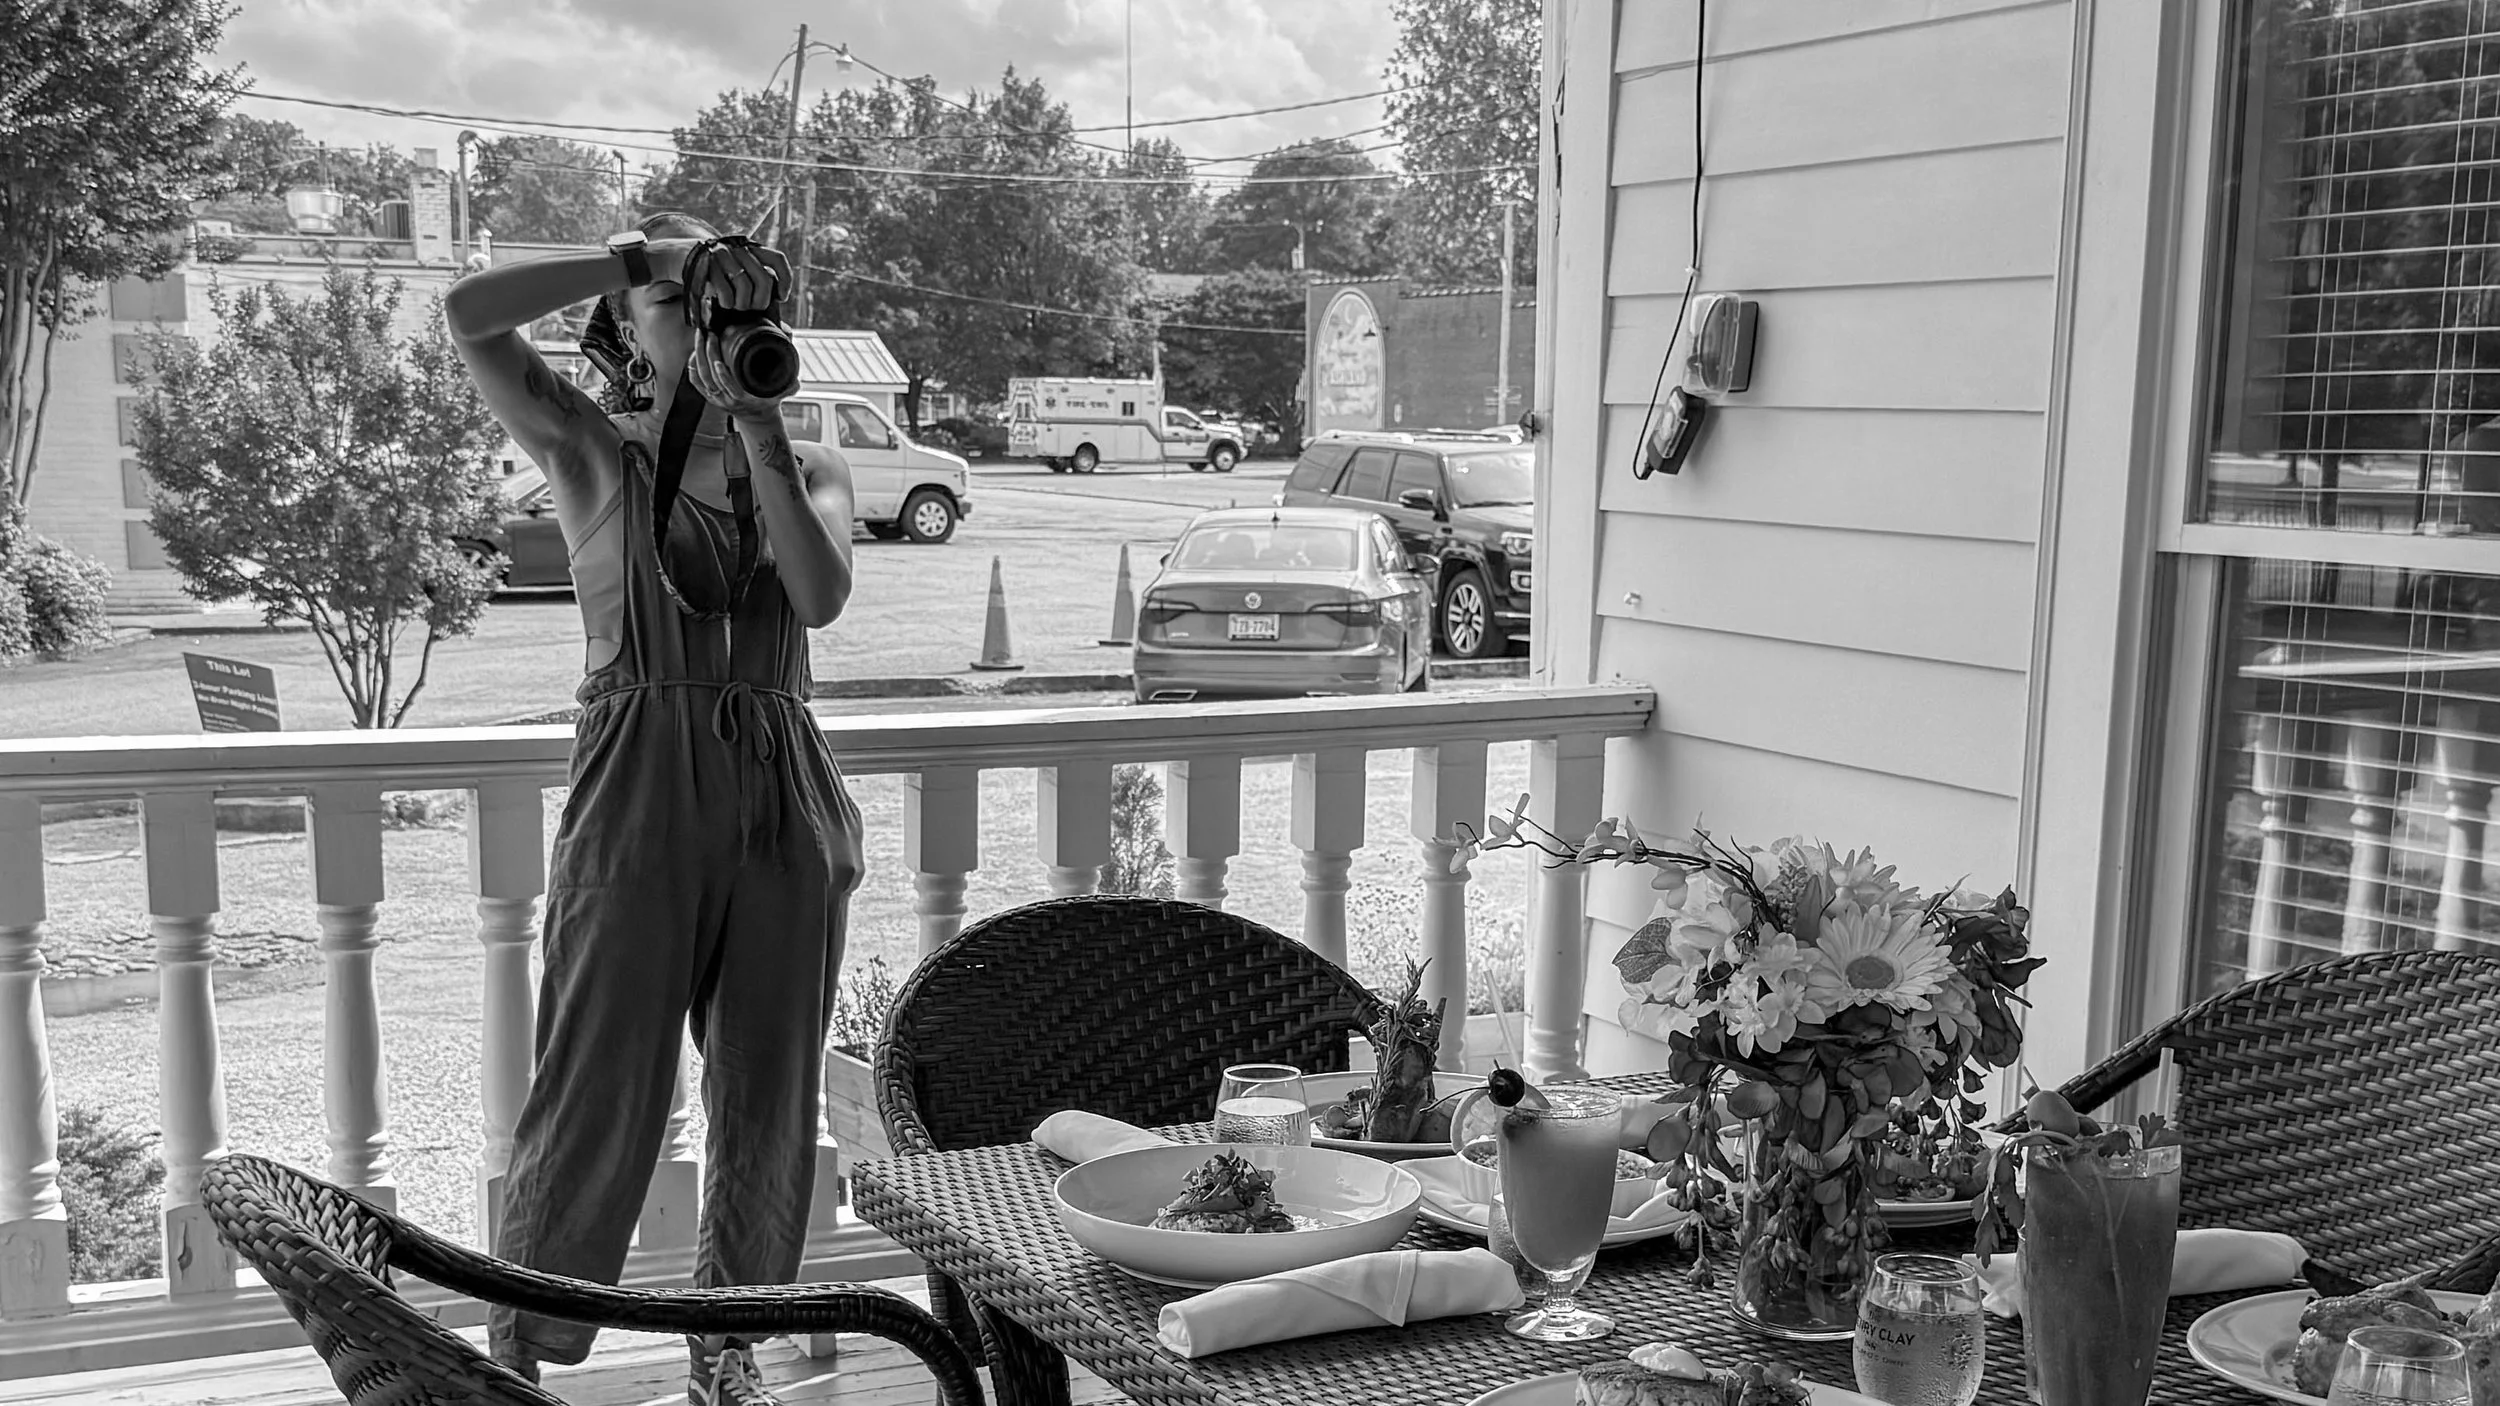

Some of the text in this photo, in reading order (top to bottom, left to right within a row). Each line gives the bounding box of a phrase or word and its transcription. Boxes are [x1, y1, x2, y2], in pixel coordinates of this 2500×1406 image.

[206, 660, 252, 678] This Lot
[1878, 1328, 1916, 1346] CLAY
